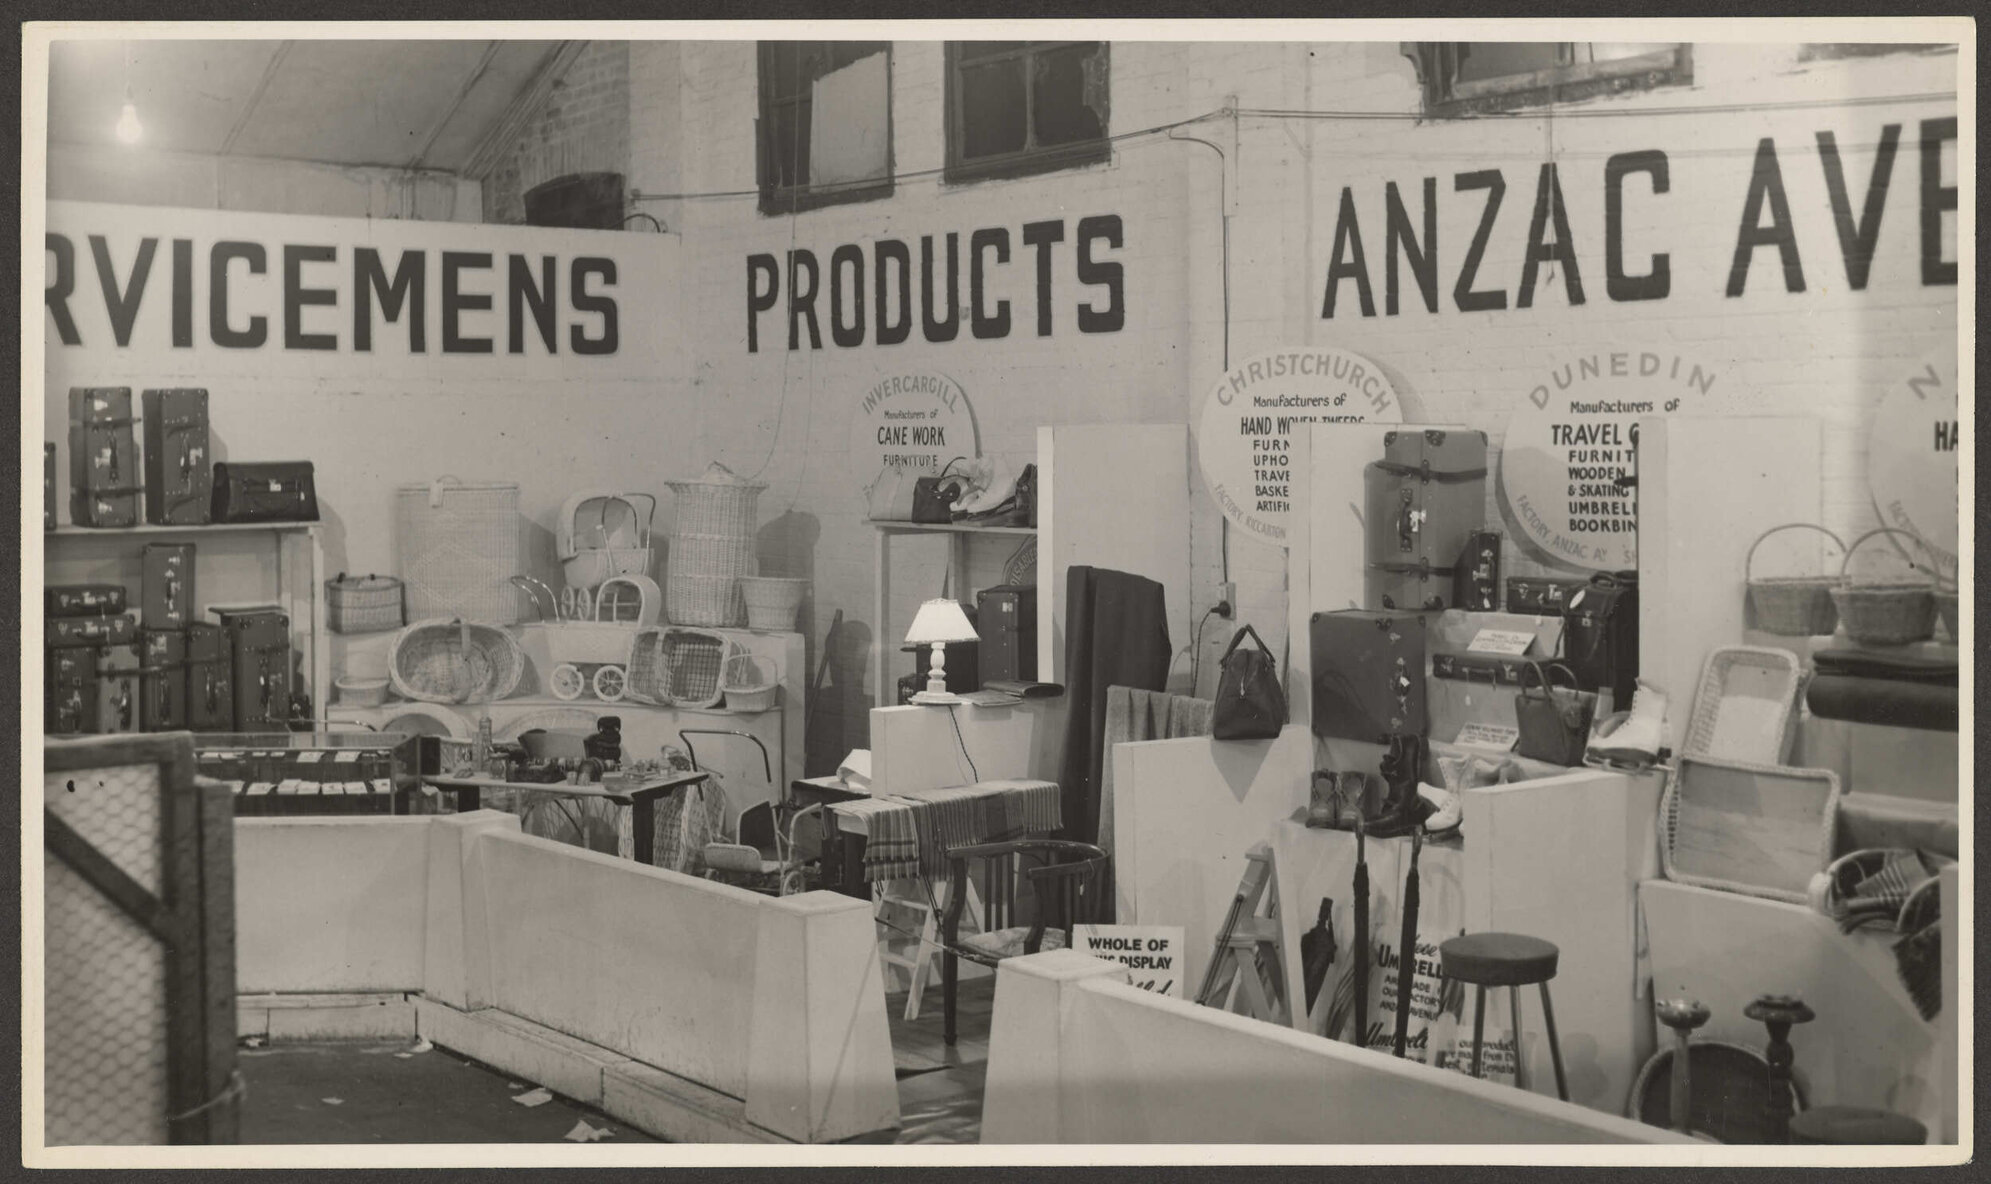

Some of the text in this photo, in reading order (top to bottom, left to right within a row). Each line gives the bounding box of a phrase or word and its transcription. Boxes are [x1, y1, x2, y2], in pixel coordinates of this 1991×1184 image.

[1322, 117, 1957, 318] ANZAC AVE
[746, 214, 1125, 353] PRODUCTS
[1217, 353, 1391, 415] CHRISTCHURCH
[1529, 352, 1716, 410] DUNEDIN
[862, 376, 957, 414] INVERCARGILL
[1253, 393, 1347, 408] Manufacturers of
[1570, 399, 1680, 413] Manufacturers of
[884, 409, 938, 419] Manufacturers of
[1241, 417, 1272, 435] HAND
[877, 427, 945, 446] CANE WORK
[1552, 424, 1622, 445] TRAVEL
[1254, 455, 1288, 466] UPHO
[1568, 450, 1635, 462] FURNIT
[1568, 467, 1626, 480] WOODEN
[1256, 486, 1289, 497] BASKE
[1579, 485, 1629, 497] SKATING
[1088, 937, 1169, 952] WHOLE OF
